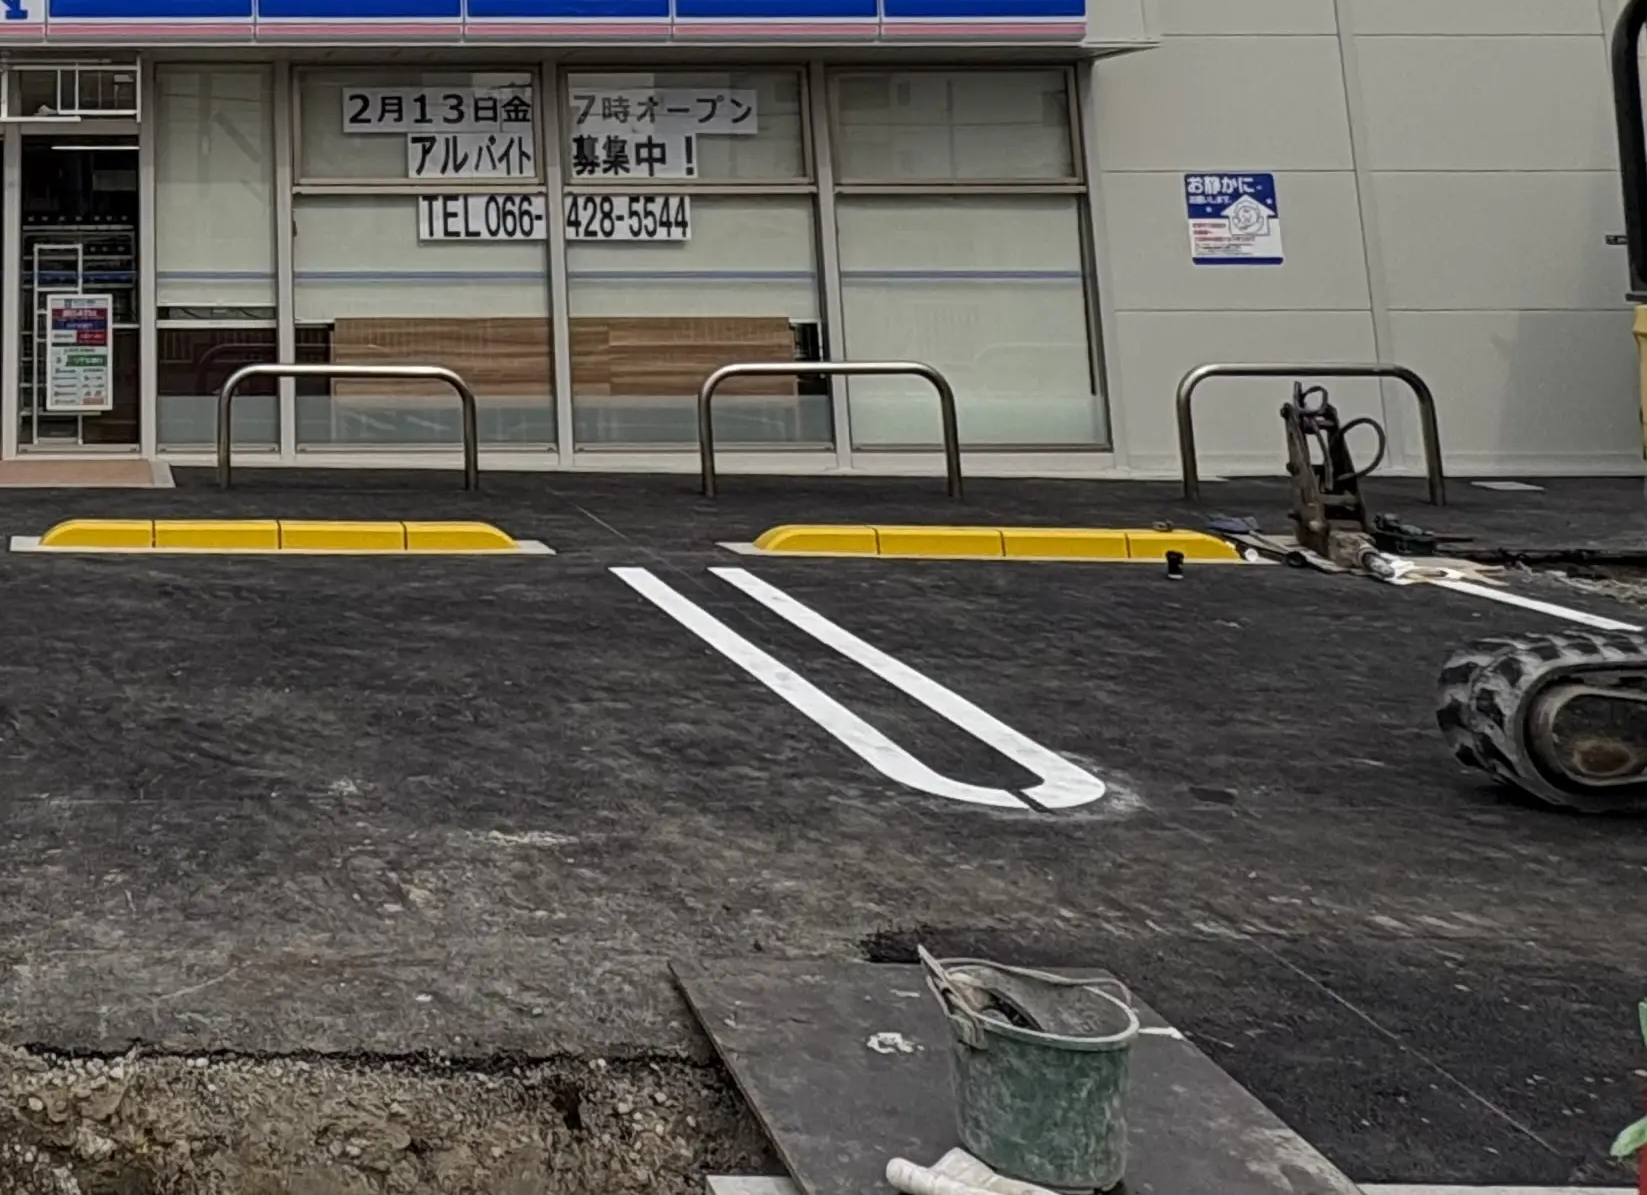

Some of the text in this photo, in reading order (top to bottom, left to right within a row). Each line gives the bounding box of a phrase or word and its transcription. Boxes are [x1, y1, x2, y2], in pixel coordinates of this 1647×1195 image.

[349, 94, 752, 124] 2月13日金 7時オープン
[411, 135, 531, 175] アルバイト
[566, 195, 689, 237] 428-5544
